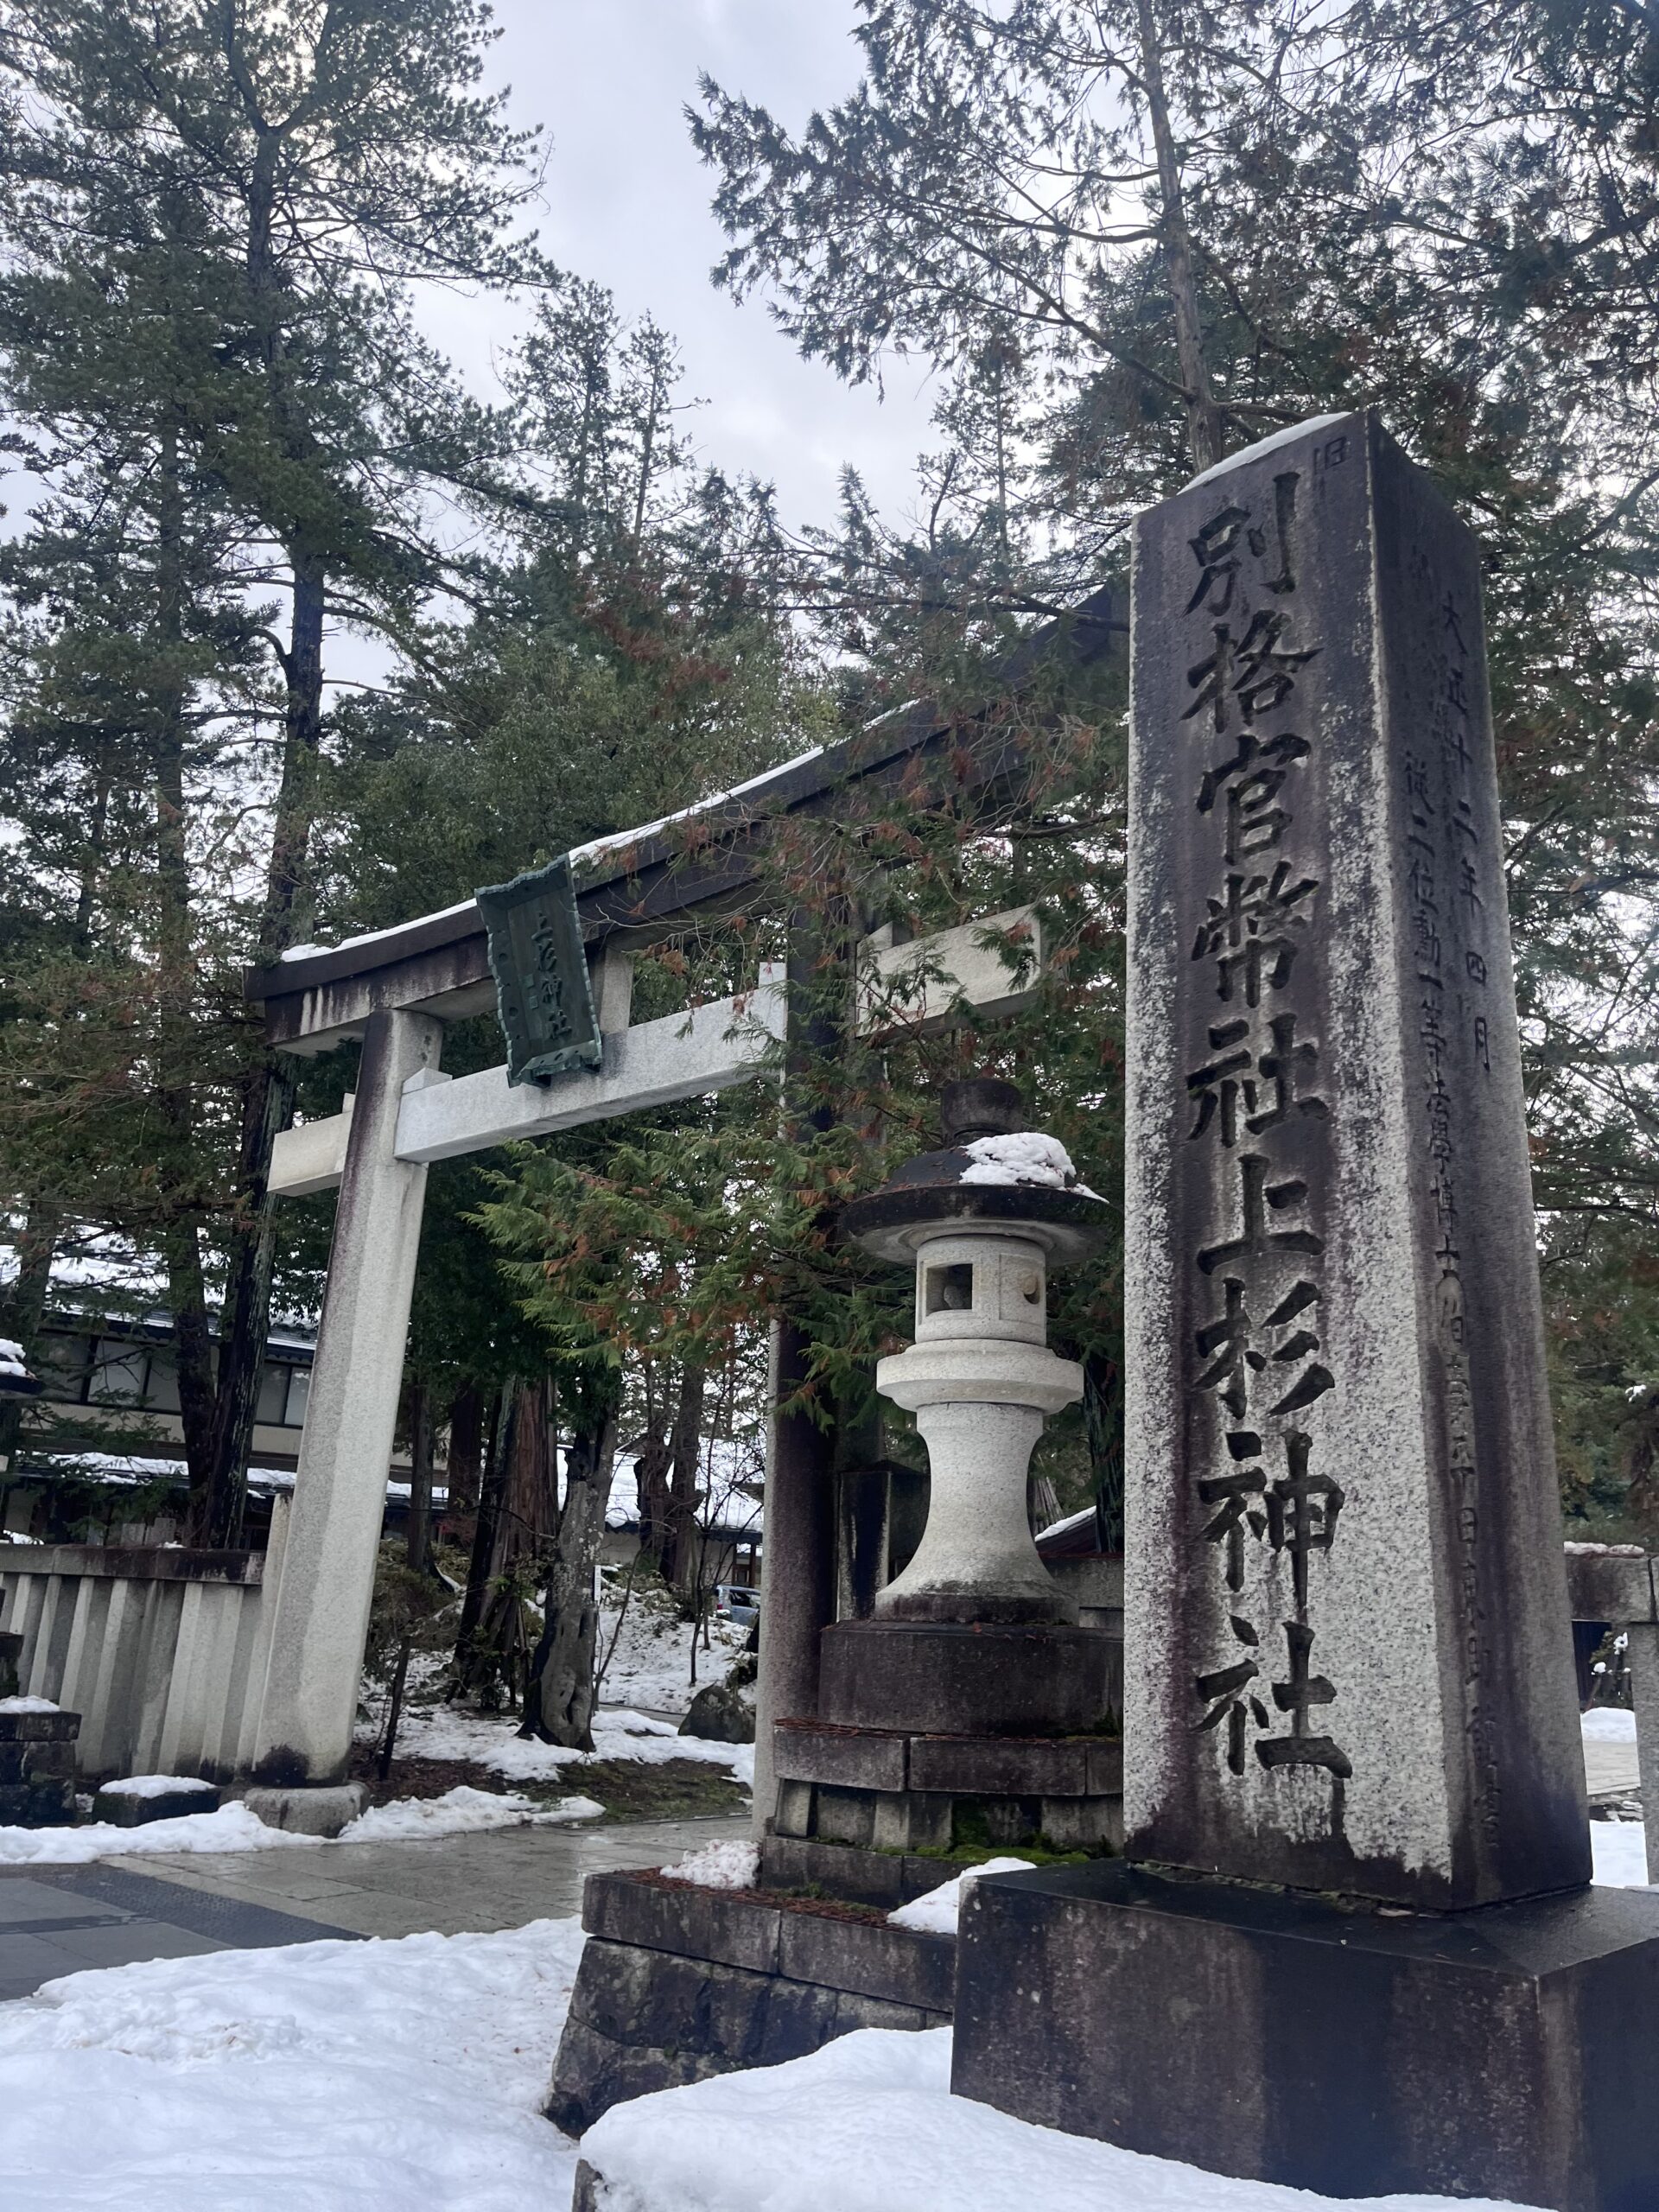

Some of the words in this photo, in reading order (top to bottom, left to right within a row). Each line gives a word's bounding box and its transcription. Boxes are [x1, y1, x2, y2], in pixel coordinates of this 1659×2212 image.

[531, 910, 573, 1041] 上杉神社
[1179, 469, 1354, 1780] 別格官幣社上杉神社
